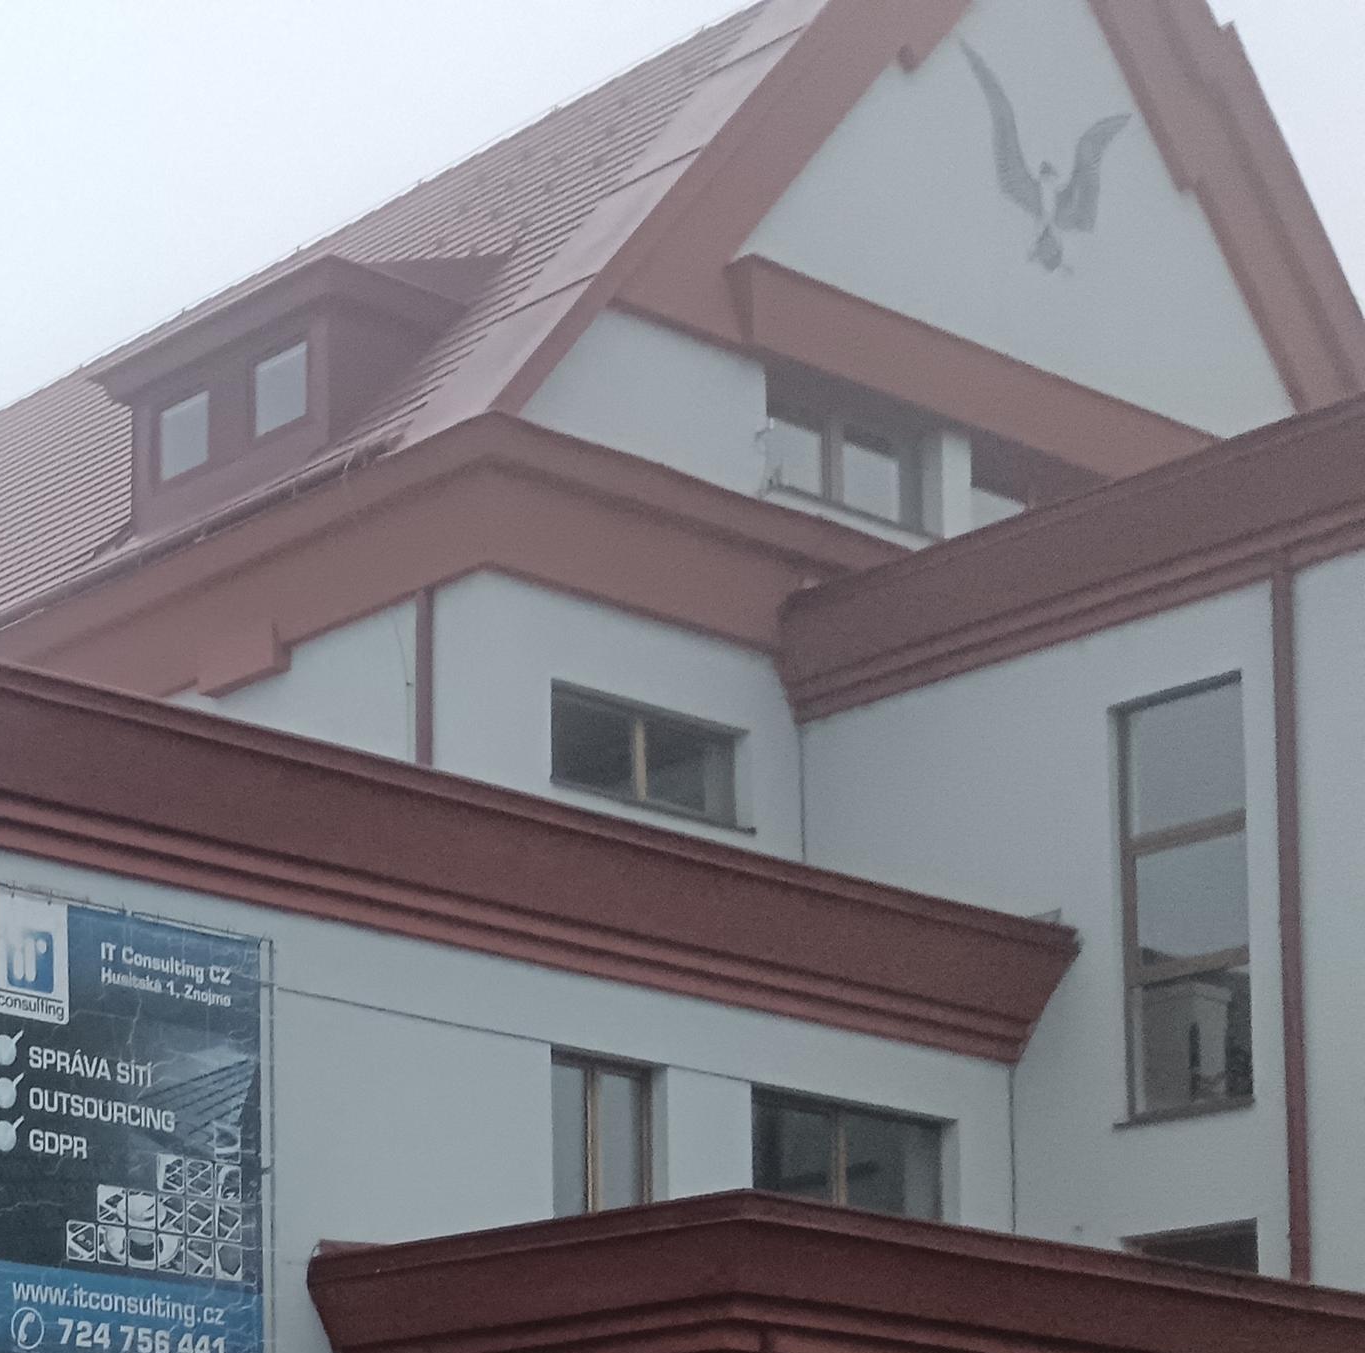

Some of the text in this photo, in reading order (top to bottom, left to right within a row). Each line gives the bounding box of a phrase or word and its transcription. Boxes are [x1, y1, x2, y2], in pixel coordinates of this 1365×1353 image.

[100, 942, 232, 986] IT Consulting CZ
[184, 986, 232, 1008] Znojmo
[29, 1046, 152, 1088] SPRÁVA SÍTÍ
[29, 1087, 176, 1133] OUTSOURCING
[29, 1129, 88, 1159] GDPR
[12, 1282, 226, 1328] www.itconsulting.cz
[58, 1317, 111, 1349] 724
